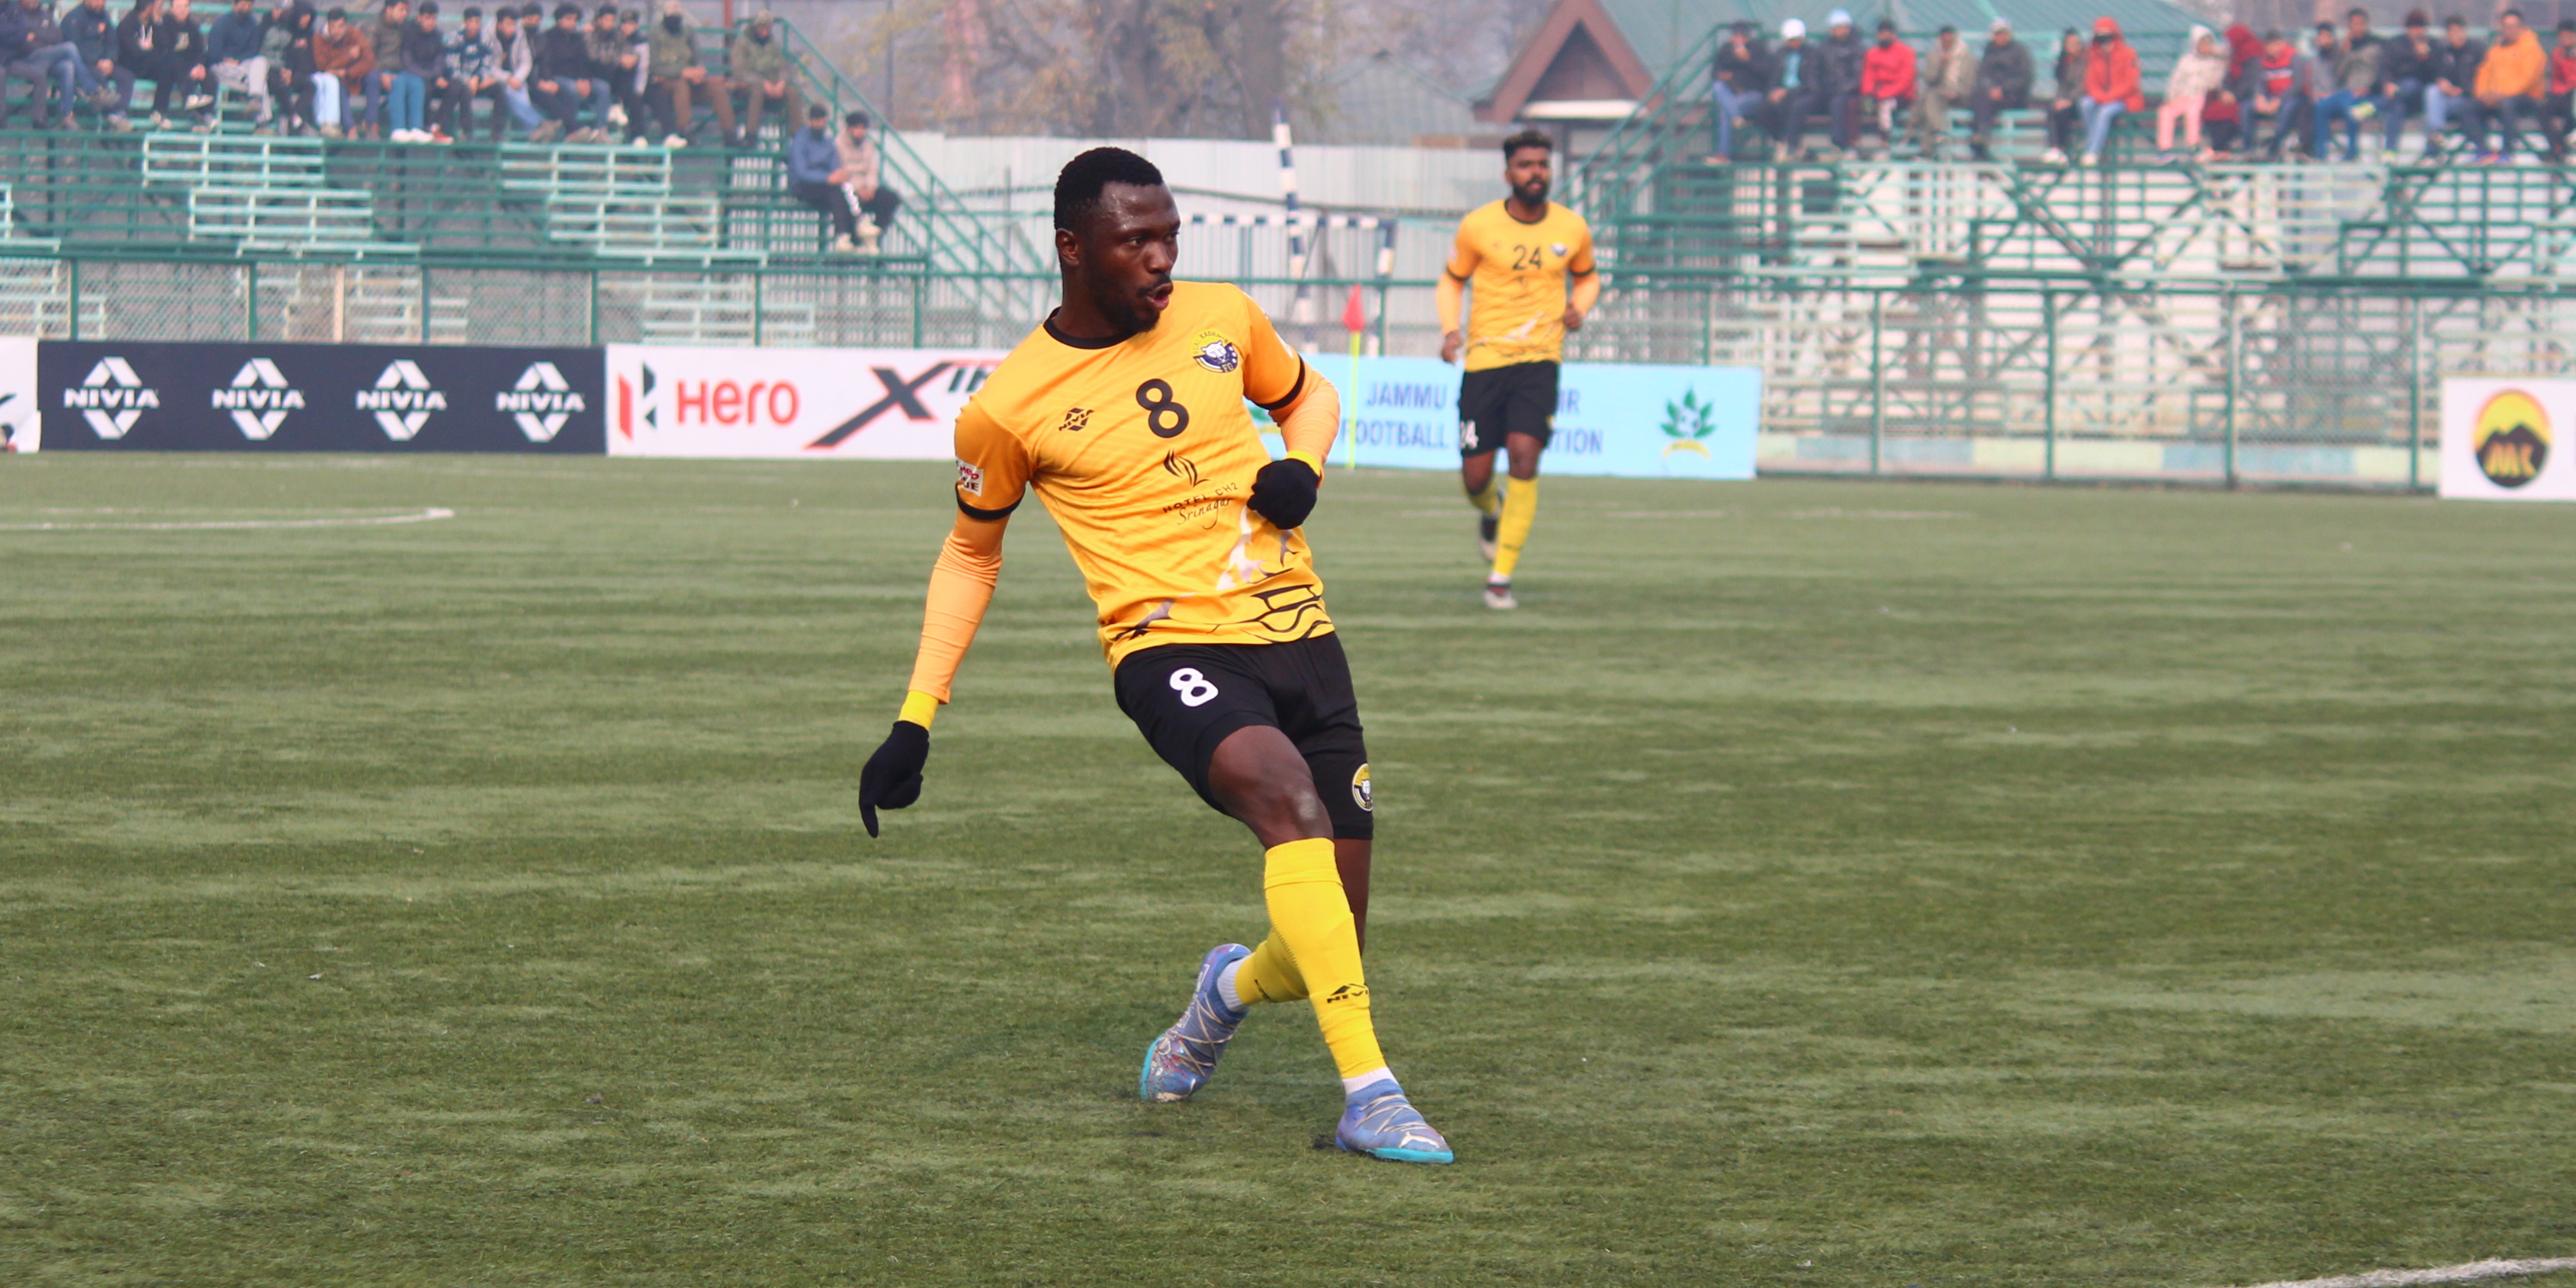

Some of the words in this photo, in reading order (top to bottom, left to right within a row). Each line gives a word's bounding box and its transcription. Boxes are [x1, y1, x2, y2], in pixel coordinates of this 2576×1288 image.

[1512, 244, 1543, 270] 24
[1222, 362, 1235, 373] FC
[64, 388, 159, 408] NIVIA
[212, 389, 305, 408] NIVIA
[356, 390, 447, 410] NIVIA
[496, 392, 585, 411] NIVIA
[676, 379, 800, 426] Hero
[1135, 378, 1190, 439] 8
[1367, 382, 1449, 410] JAMMU
[1340, 418, 1449, 448] FOOTBALL
[1163, 494, 1211, 513] HOTEL
[1215, 482, 1239, 496] CH2
[1177, 497, 1235, 531] Srinagar
[1169, 667, 1219, 708] 8
